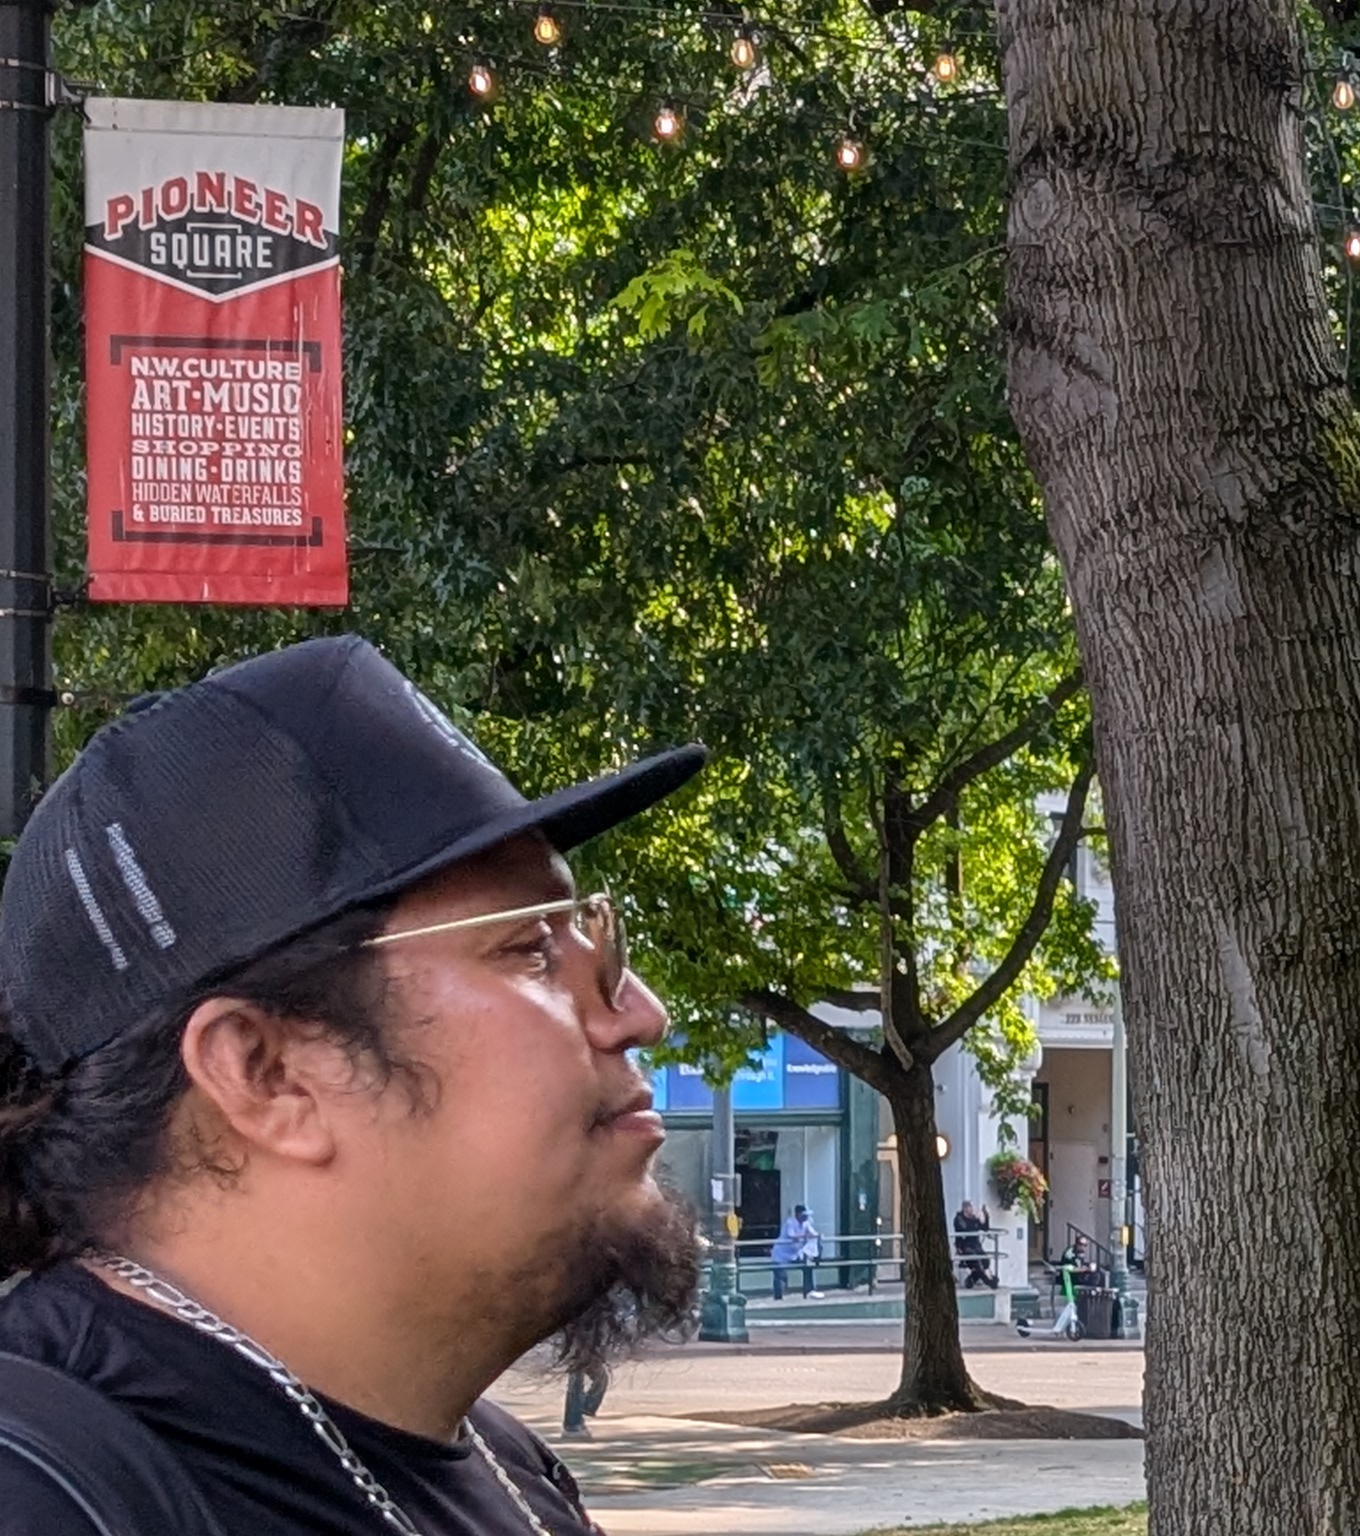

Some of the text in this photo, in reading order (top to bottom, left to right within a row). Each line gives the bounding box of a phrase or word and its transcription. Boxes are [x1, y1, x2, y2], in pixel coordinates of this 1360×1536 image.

[104, 171, 328, 249] PIONEER
[150, 232, 273, 269] SQUARE
[131, 439, 302, 458] SHOPPING
[131, 482, 302, 506] HIDDEN WATERFALLS
[132, 504, 303, 526] & BURIED TREASURES
